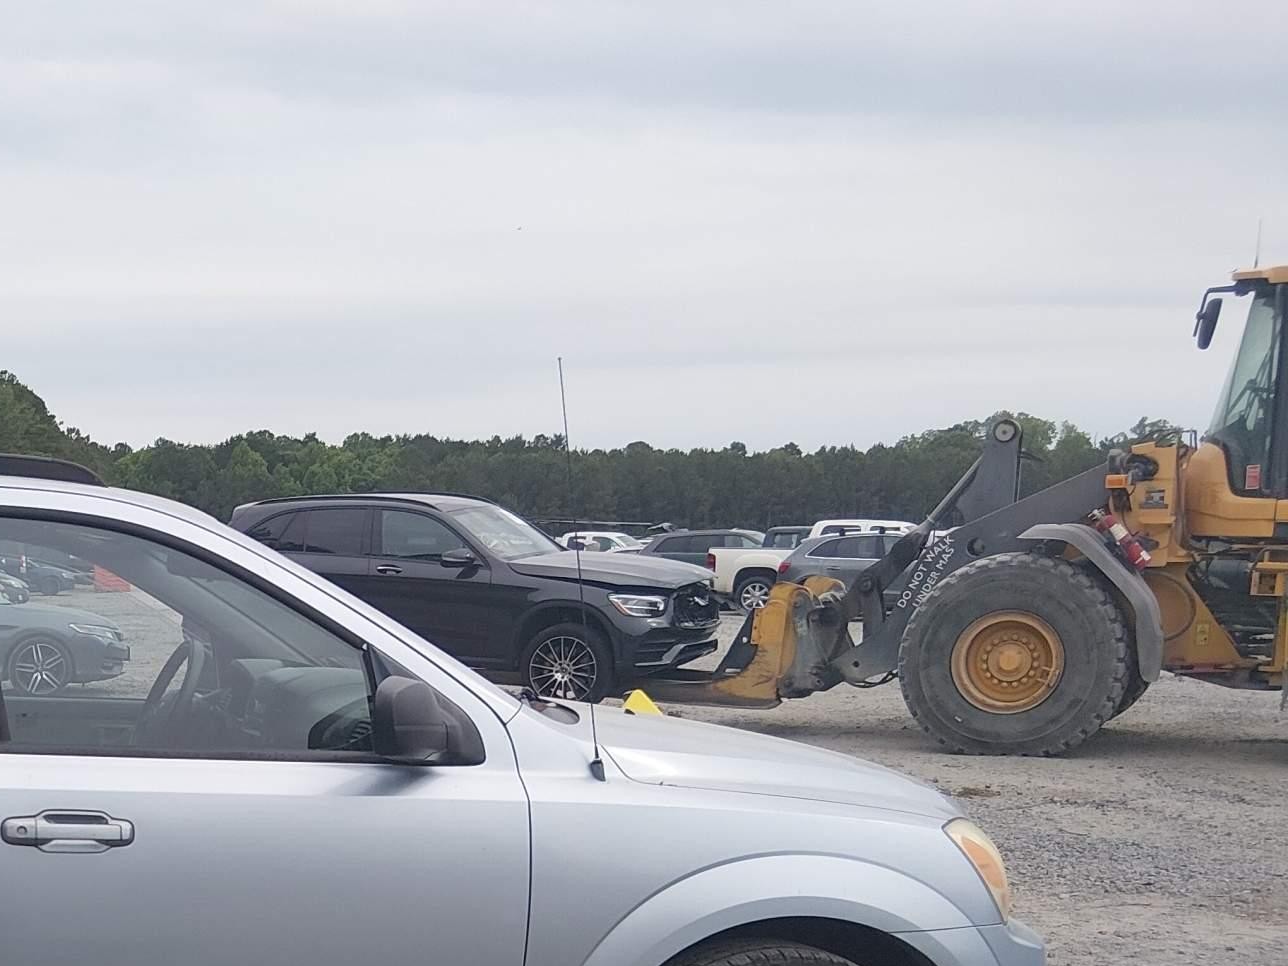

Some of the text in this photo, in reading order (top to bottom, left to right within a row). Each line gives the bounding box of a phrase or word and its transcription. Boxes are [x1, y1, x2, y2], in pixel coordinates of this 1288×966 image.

[897, 535, 954, 608] DO NOT WALK
[912, 571, 941, 607] UNDER
